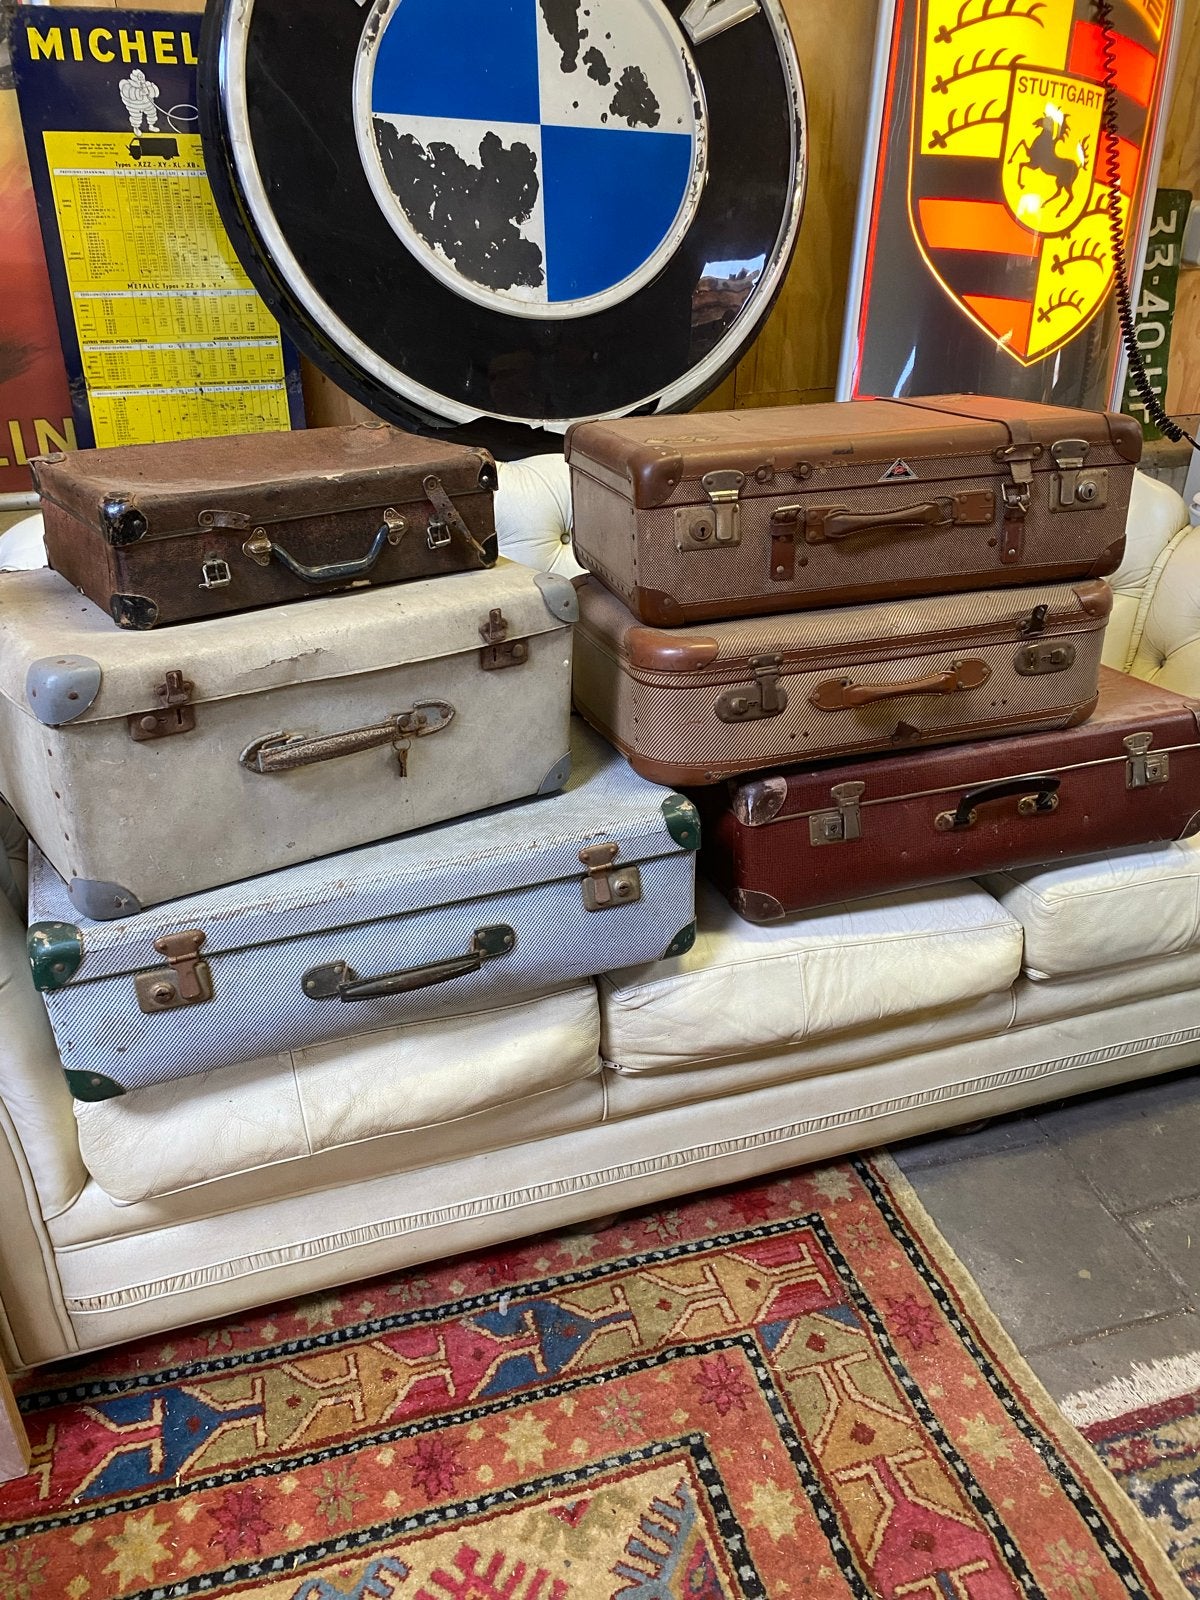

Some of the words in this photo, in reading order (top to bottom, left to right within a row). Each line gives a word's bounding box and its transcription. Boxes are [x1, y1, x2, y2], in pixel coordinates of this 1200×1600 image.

[1018, 76, 1102, 109] STUTTGART
[115, 161, 131, 169] Types
[0, 418, 78, 467] IN
